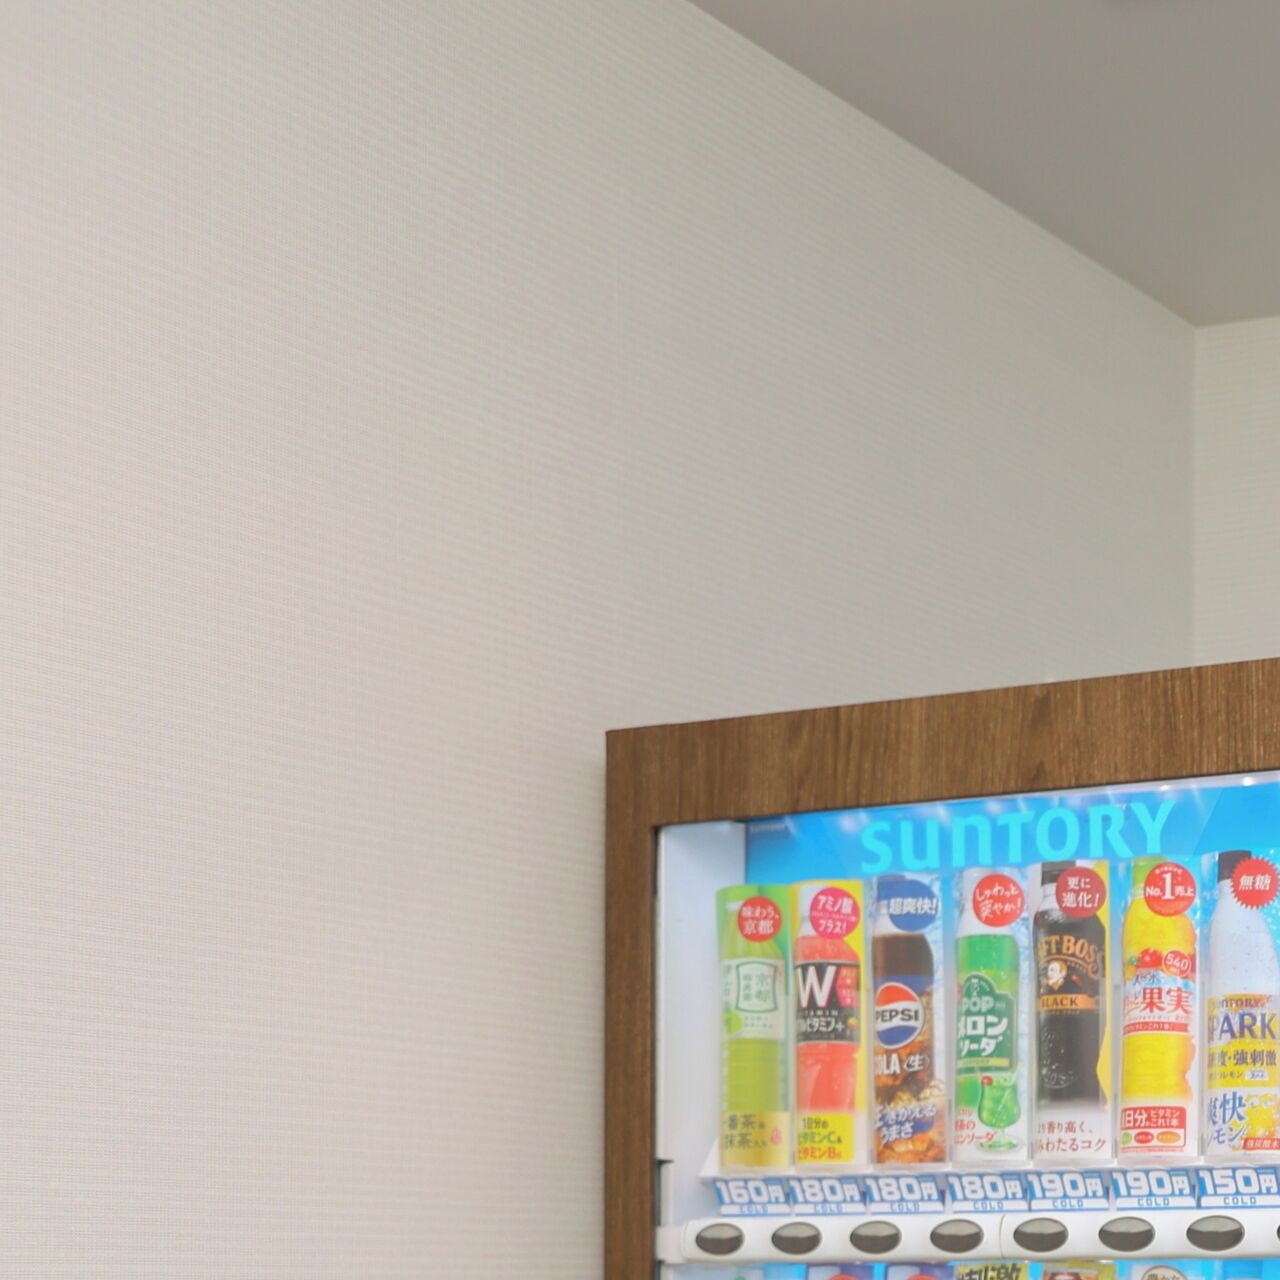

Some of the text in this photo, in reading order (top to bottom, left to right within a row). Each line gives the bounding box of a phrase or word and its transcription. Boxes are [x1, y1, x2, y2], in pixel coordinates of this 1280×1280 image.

[1067, 876, 1091, 888] 更に
[1239, 873, 1272, 891] 無糖
[889, 897, 938, 916] 超爽快!
[1062, 892, 1099, 908] 進化!
[979, 900, 1023, 921] 爽やか!
[743, 920, 774, 935] 京都
[799, 965, 837, 1008] W
[948, 1174, 1025, 1199] 180円
[1112, 1171, 1191, 1195] 190円
[1052, 1199, 1084, 1208] COLD
